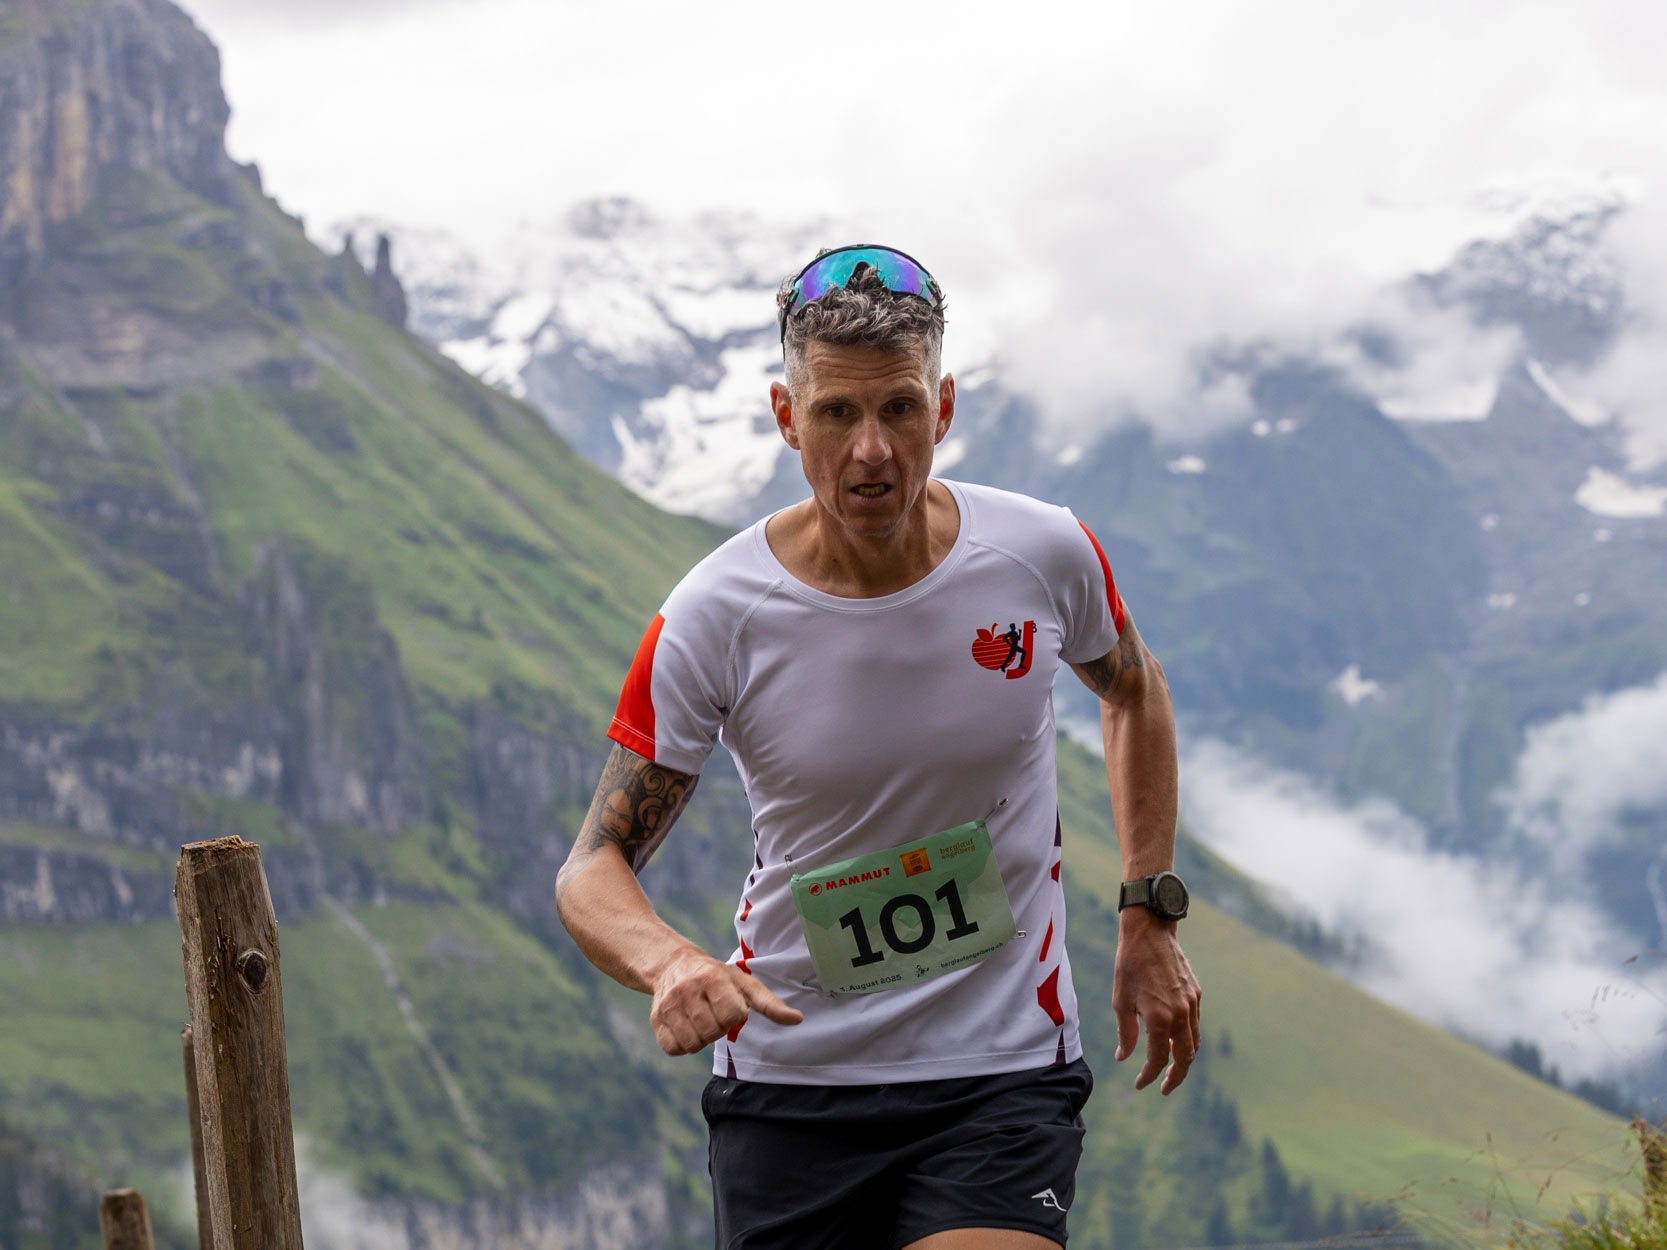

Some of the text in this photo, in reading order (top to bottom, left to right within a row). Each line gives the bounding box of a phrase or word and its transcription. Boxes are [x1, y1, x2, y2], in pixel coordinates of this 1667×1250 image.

[939, 838, 974, 853] berglauf
[826, 867, 891, 891] MAMMUT
[839, 878, 979, 968] 101
[849, 980, 879, 992] August
[880, 974, 902, 985] 2025
